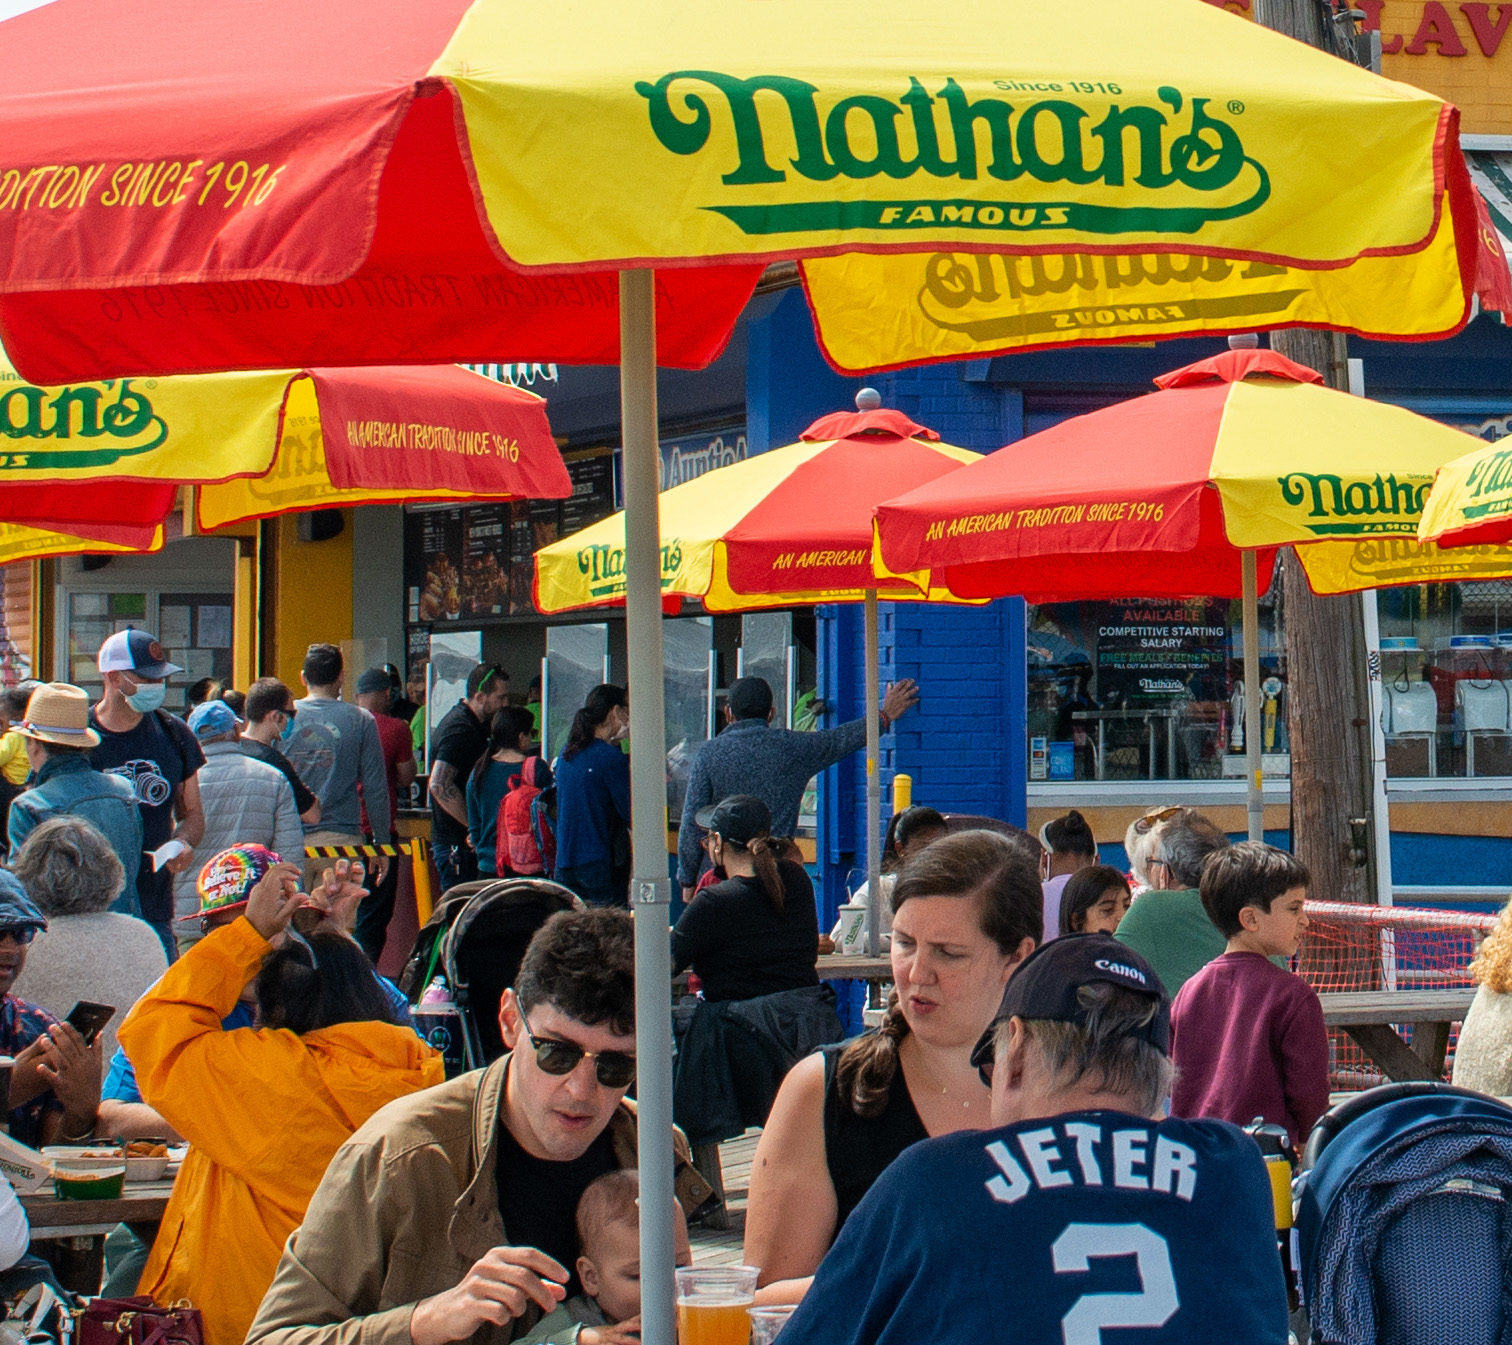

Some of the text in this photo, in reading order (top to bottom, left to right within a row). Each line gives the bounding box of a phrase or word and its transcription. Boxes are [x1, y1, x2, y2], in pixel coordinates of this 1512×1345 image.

[993, 78, 1123, 97] Since 1916
[635, 70, 1248, 192] Nathan's
[101, 159, 203, 208] SINCE
[199, 160, 286, 209] 1916
[879, 205, 1071, 227] FAMOUS
[492, 433, 520, 463] 1916
[925, 501, 1166, 542] AN AMERICAN TRADITION SINCE 1916
[577, 537, 682, 581] Nan's
[772, 549, 866, 570] AN AMERICAN
[1122, 610, 1200, 622] AVAILABLE
[1099, 626, 1224, 636] COMPETITIVE STARTING
[1140, 638, 1182, 648] SALARY
[1139, 678, 1183, 689] Nathan's
[1094, 959, 1147, 985] Canon
[984, 1121, 1197, 1204] JETER
